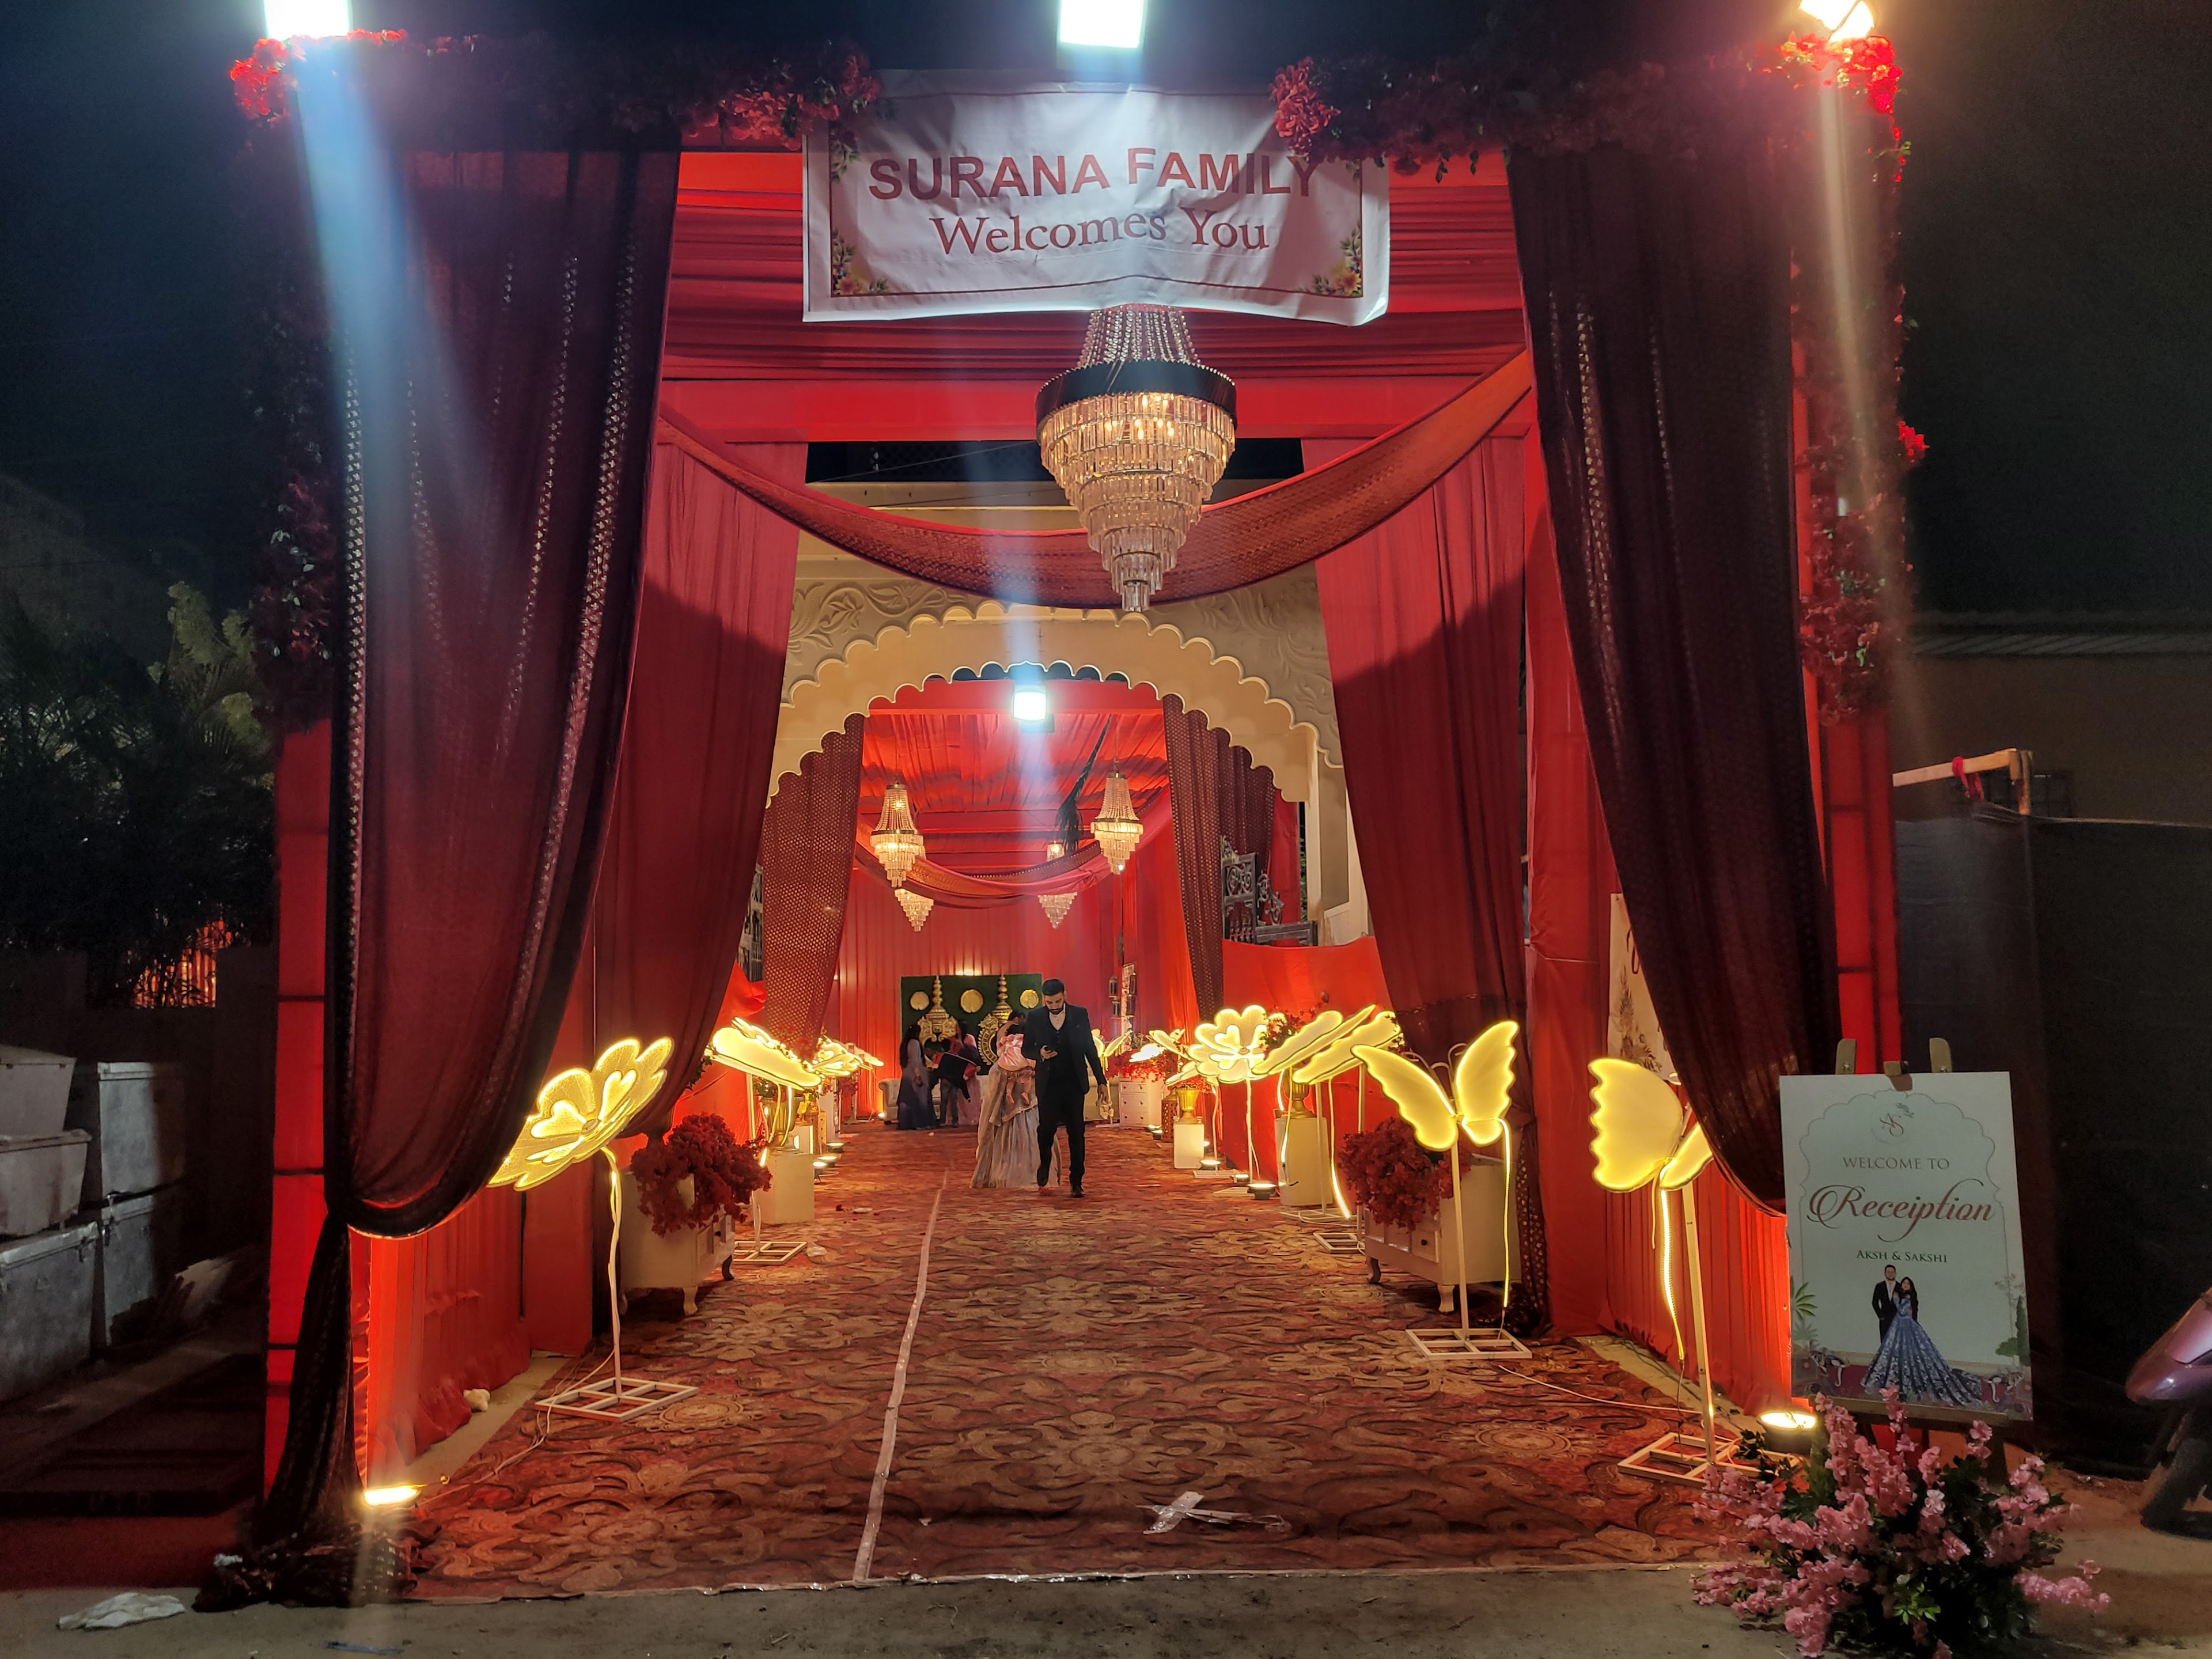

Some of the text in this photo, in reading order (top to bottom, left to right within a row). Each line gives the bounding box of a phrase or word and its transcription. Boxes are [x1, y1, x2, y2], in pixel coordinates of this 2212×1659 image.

[869, 147, 1316, 200] SURANA FAMILY
[929, 206, 1270, 254] Welcomes You
[1843, 1157, 1949, 1170] WELCOME TO
[1806, 1179, 1995, 1242] Receiption
[1856, 1249, 1948, 1263] AKSH & SAKSHI
